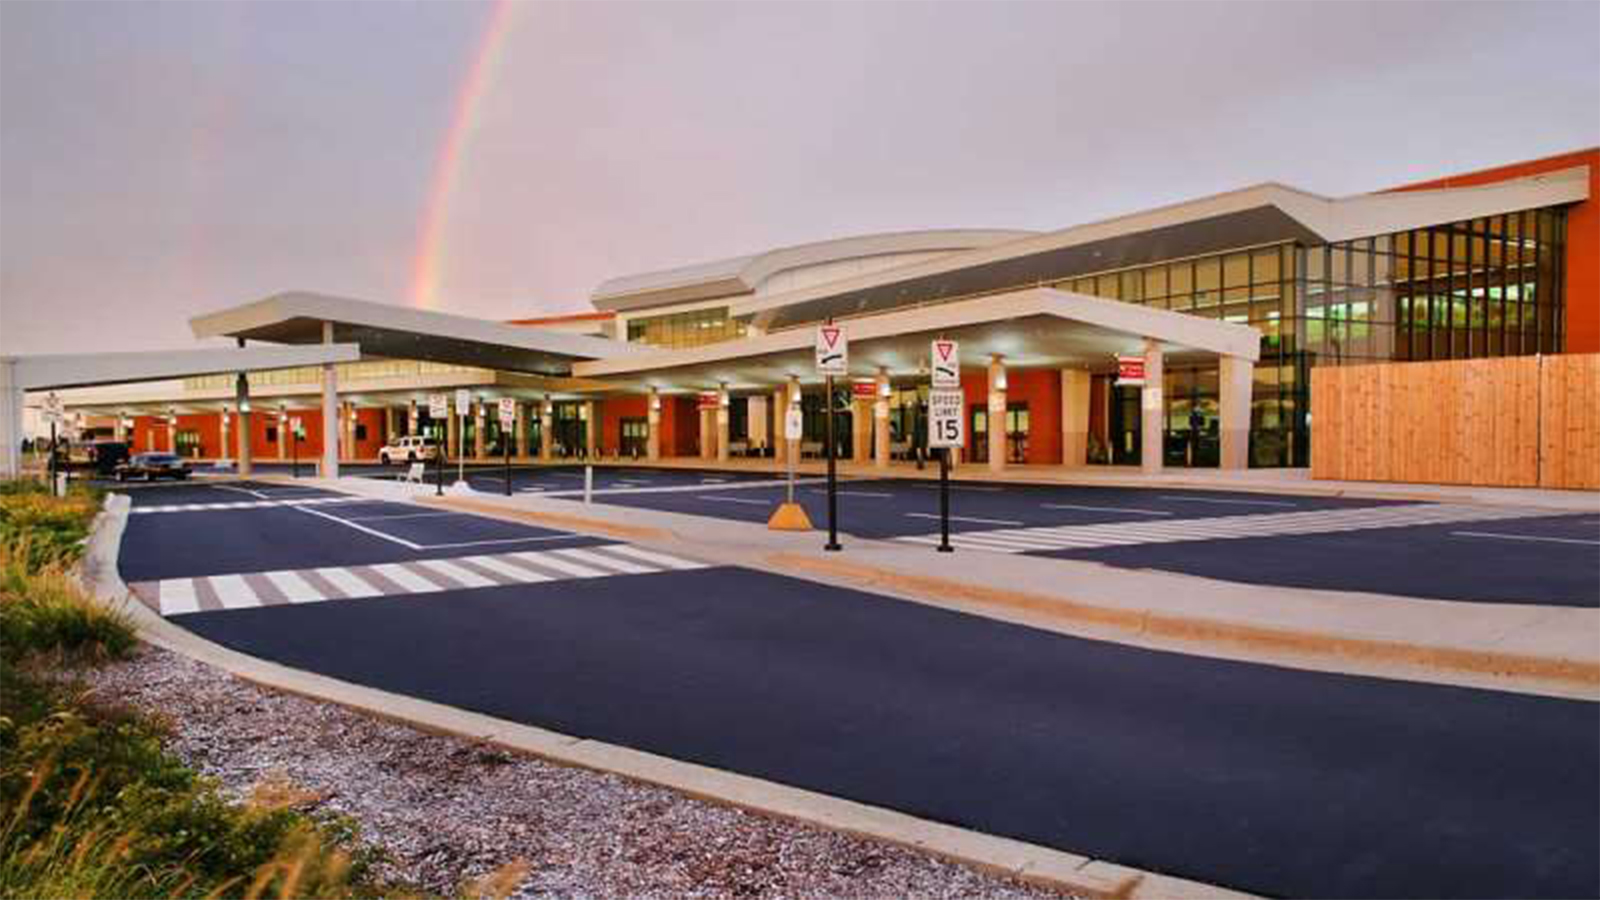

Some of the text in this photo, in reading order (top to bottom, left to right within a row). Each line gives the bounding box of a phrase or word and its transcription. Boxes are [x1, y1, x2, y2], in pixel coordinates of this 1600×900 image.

[932, 395, 960, 405] SPEED
[934, 408, 958, 417] LIMIT
[936, 419, 959, 440] 15
